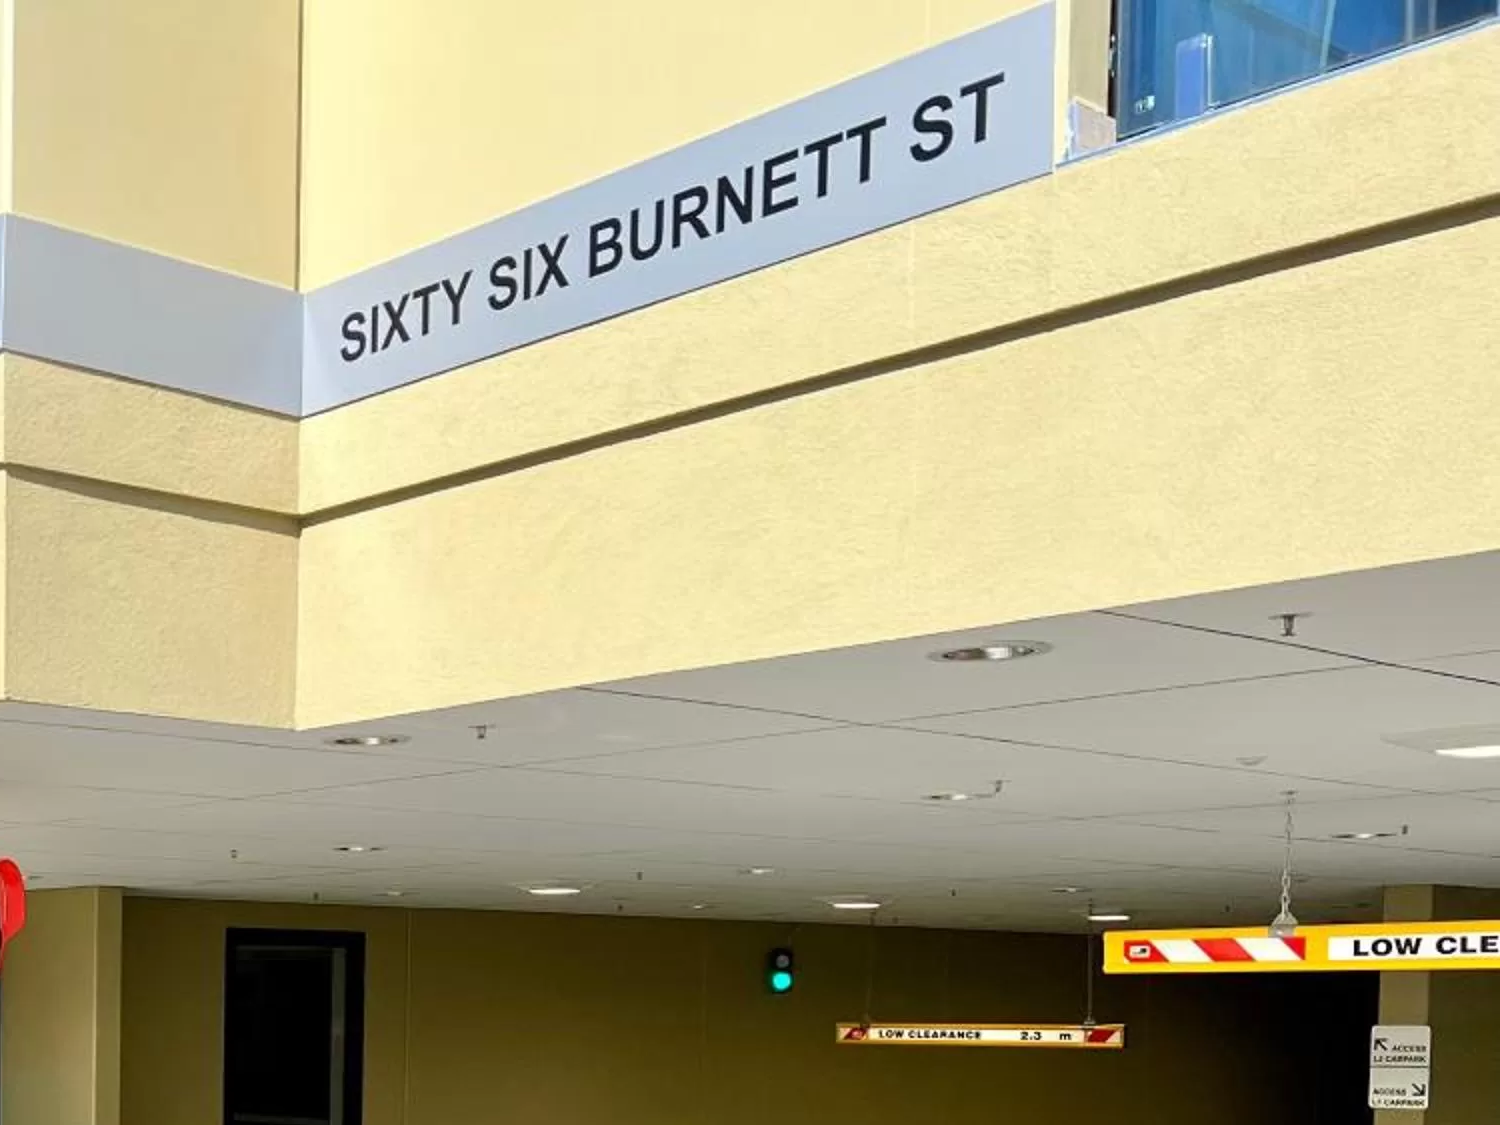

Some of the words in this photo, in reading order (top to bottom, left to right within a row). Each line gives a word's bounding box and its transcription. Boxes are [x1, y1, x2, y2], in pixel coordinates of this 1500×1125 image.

[340, 271, 472, 362] SIXTY
[487, 234, 570, 312] SIX
[588, 116, 888, 279] BURNETT
[909, 72, 1005, 163] ST
[1352, 937, 1422, 957] LOW
[879, 1029, 904, 1039] LOW
[908, 1030, 982, 1039] CLEARANCE
[1020, 1031, 1042, 1041] 2.3
[1059, 1033, 1072, 1041] m
[1391, 1044, 1427, 1053] ACCESS
[1386, 1055, 1427, 1063] CARPARK
